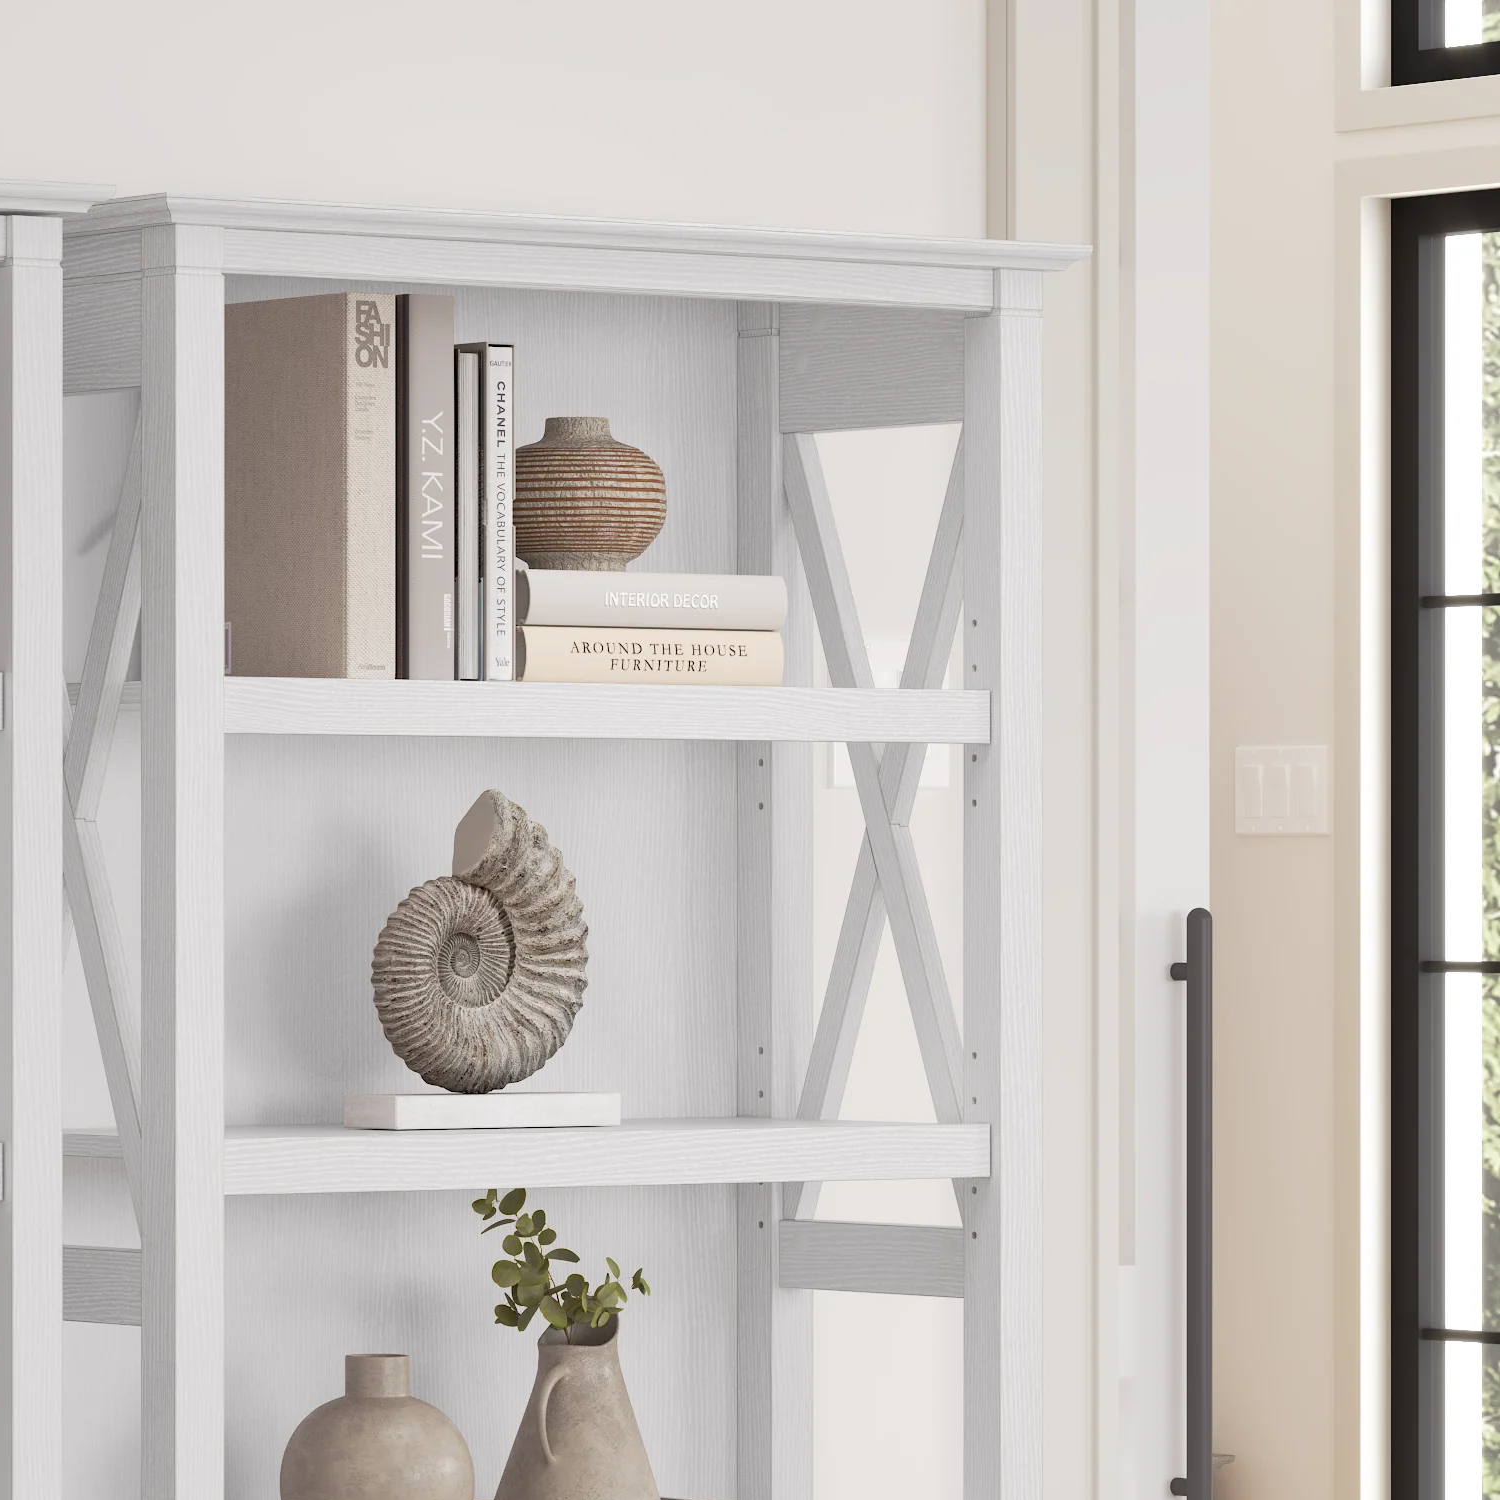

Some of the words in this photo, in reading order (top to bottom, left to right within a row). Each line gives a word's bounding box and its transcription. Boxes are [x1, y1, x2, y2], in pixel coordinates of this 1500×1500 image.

[496, 381, 506, 448] CHANEL
[421, 411, 444, 462] Y.Z.
[496, 453, 506, 478] THE
[421, 472, 444, 559] KAMI
[496, 483, 506, 571] VOCABULARY
[496, 576, 506, 592] OF
[604, 591, 669, 608] INTERIOR
[673, 594, 719, 609] DECOR
[496, 598, 506, 636] STYLE
[570, 641, 643, 656] AROUND
[650, 643, 684, 656] THE
[691, 644, 748, 658] HOUSE
[610, 658, 708, 673] FURNITURE
